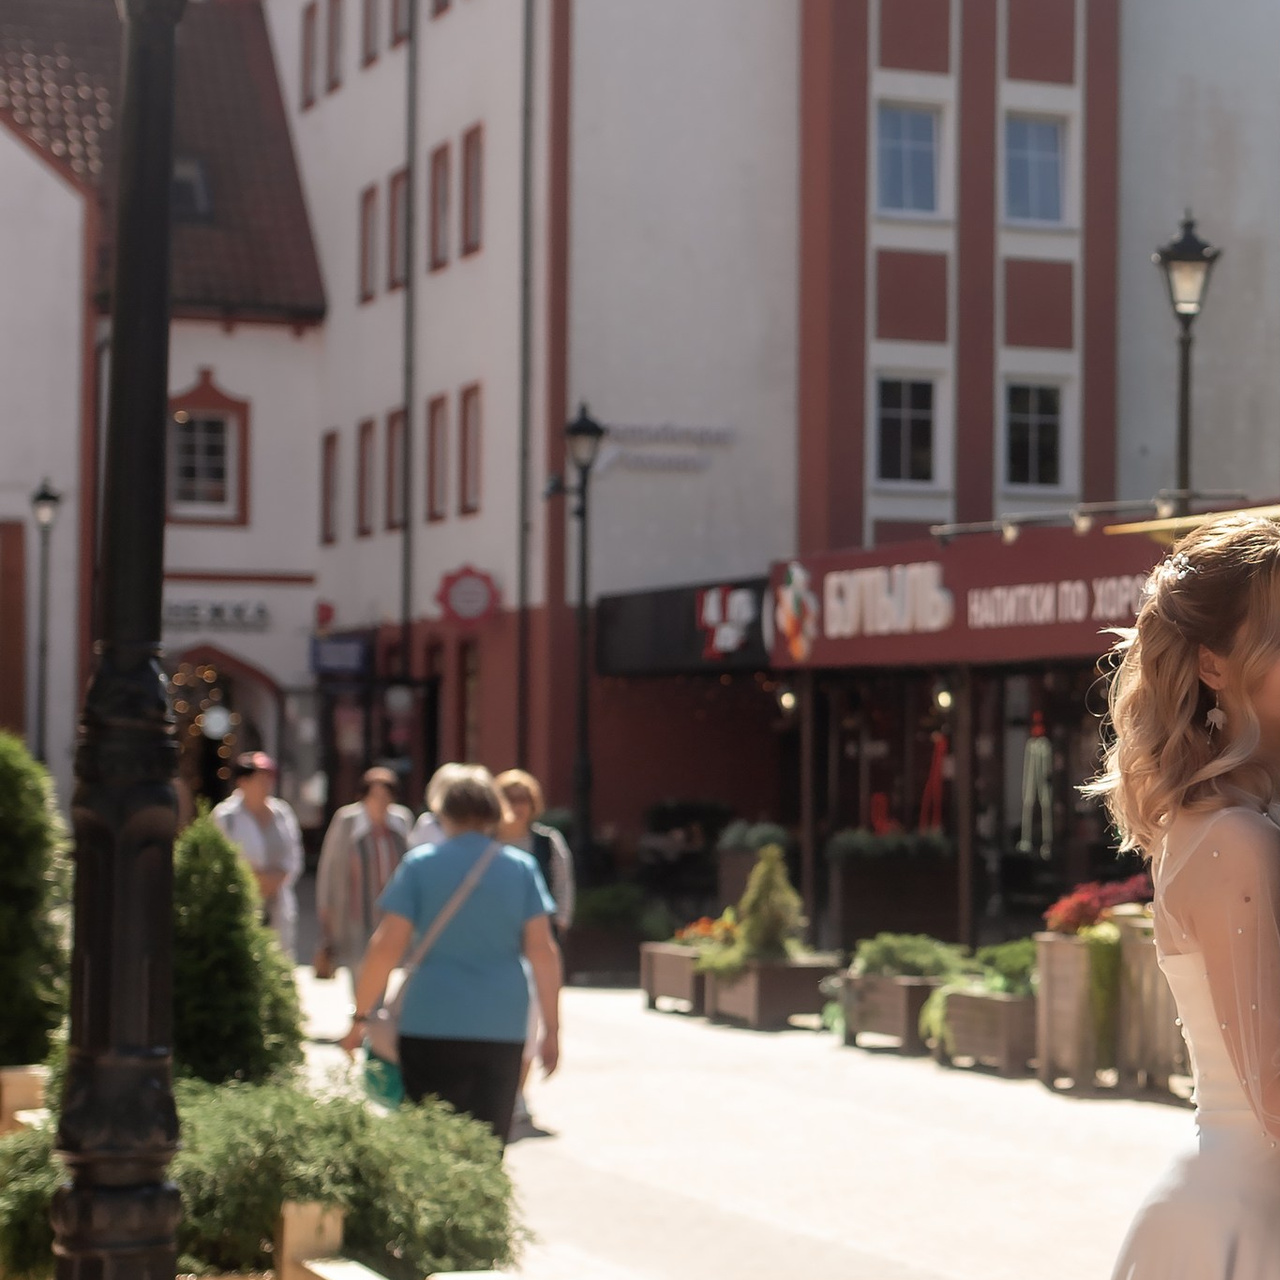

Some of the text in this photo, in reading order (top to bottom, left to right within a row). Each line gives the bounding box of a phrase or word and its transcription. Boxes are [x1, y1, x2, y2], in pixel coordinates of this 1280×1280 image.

[823, 561, 954, 639] БУТЫЛЬ
[967, 573, 1151, 629] НАПИТКИ ПО ХОРО
